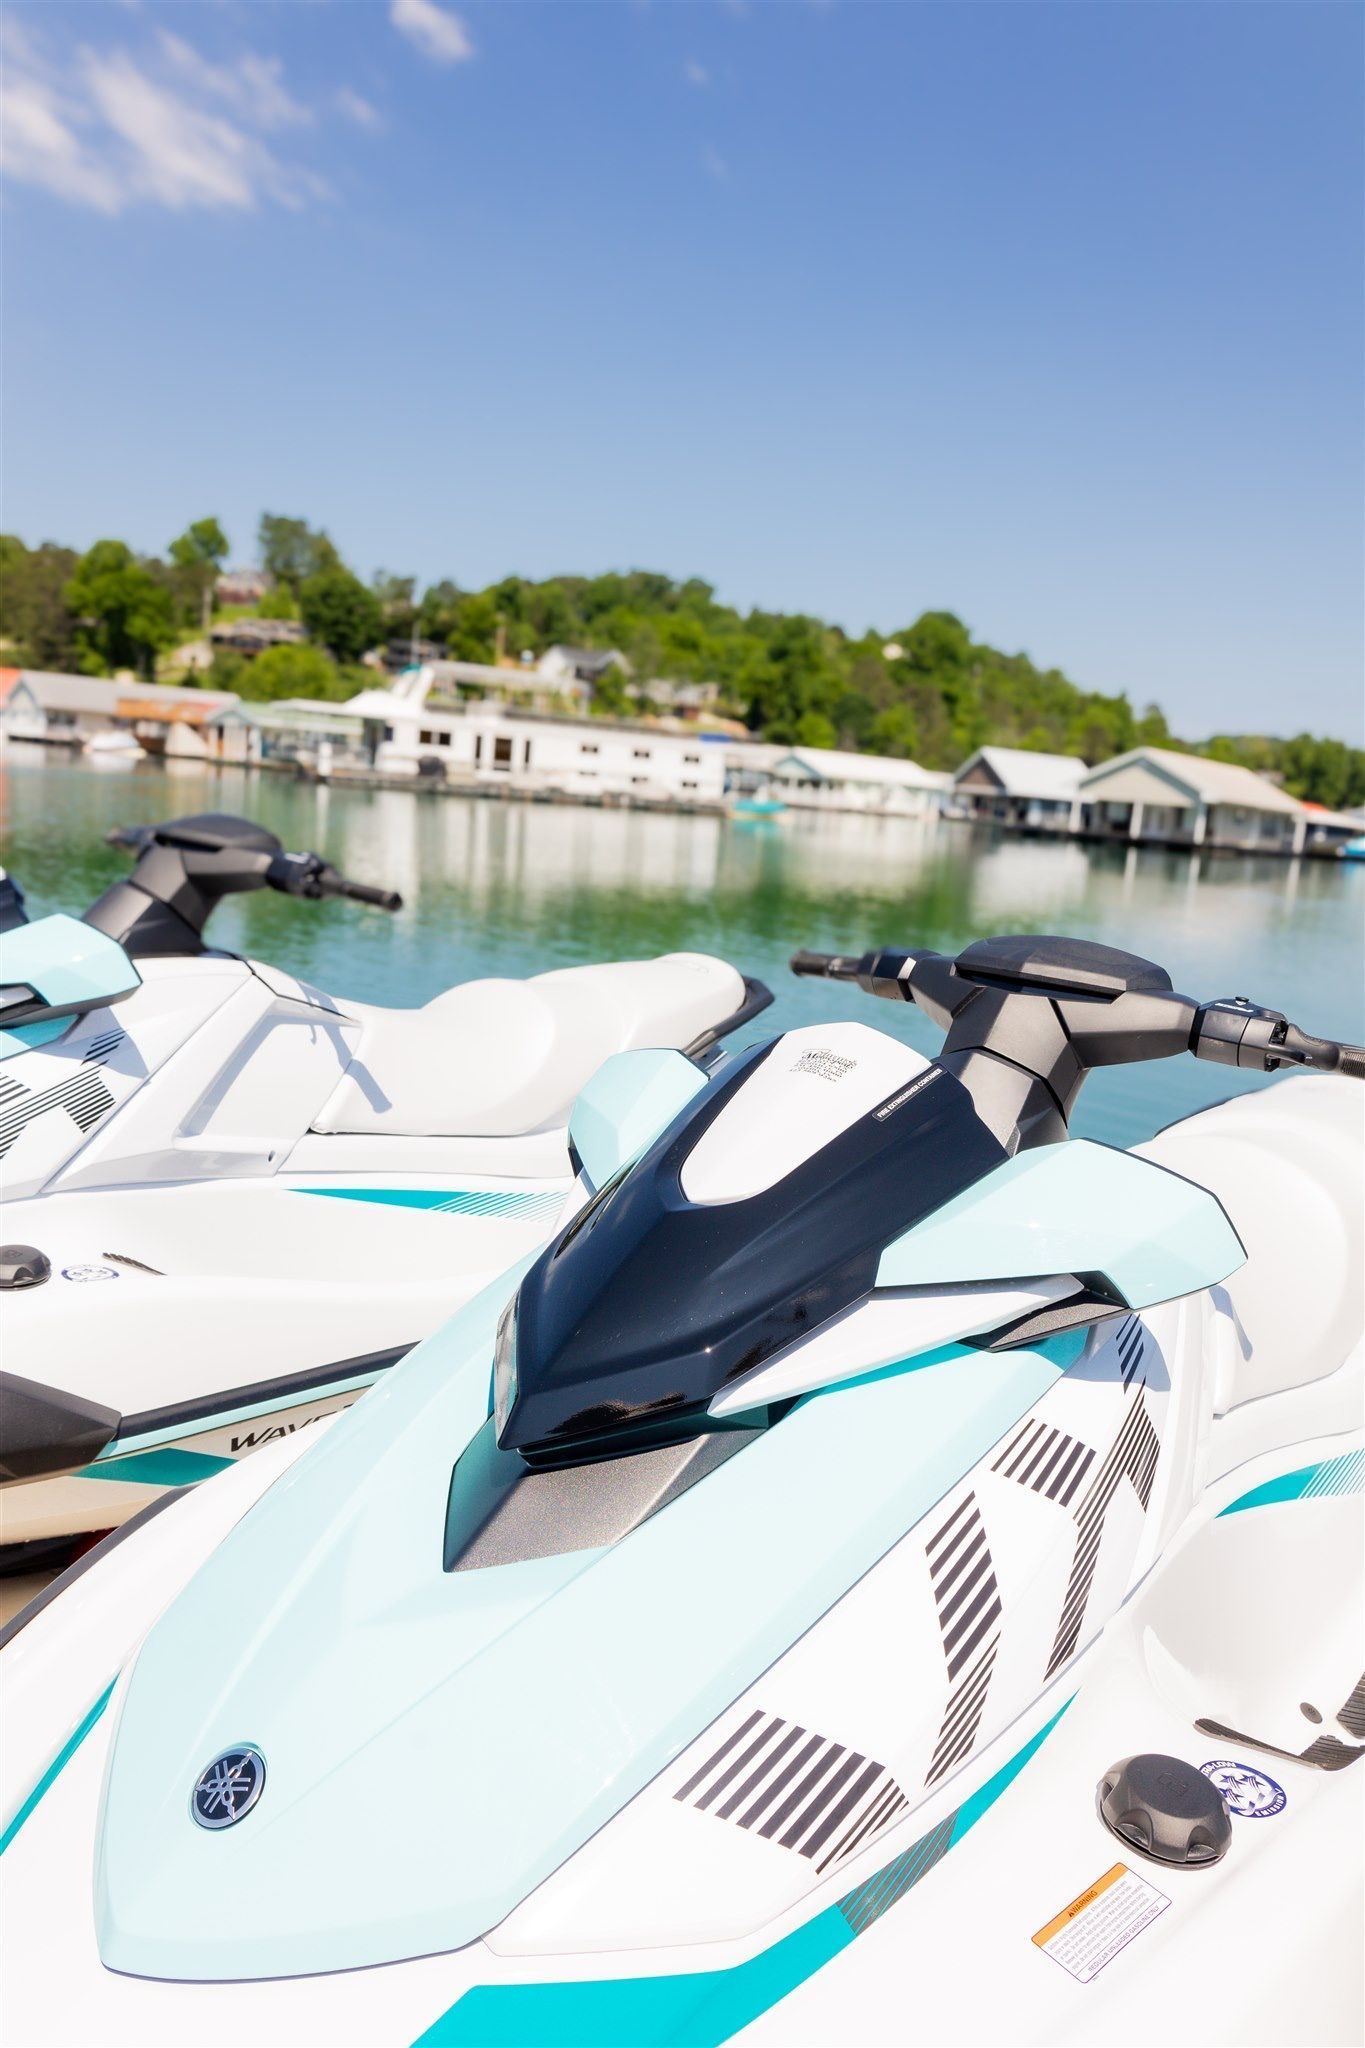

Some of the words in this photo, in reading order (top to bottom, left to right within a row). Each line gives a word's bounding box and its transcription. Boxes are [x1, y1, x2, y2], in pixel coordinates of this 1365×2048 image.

[877, 1107, 889, 1118] FIRE
[888, 1085, 919, 1110] EXTINGUISHER
[917, 1068, 943, 1087] CONTAINER
[1072, 1890, 1098, 1915] WARNING
[1087, 1952, 1110, 1973] REGULAR
[1129, 1914, 1150, 1936] GASOLINE
